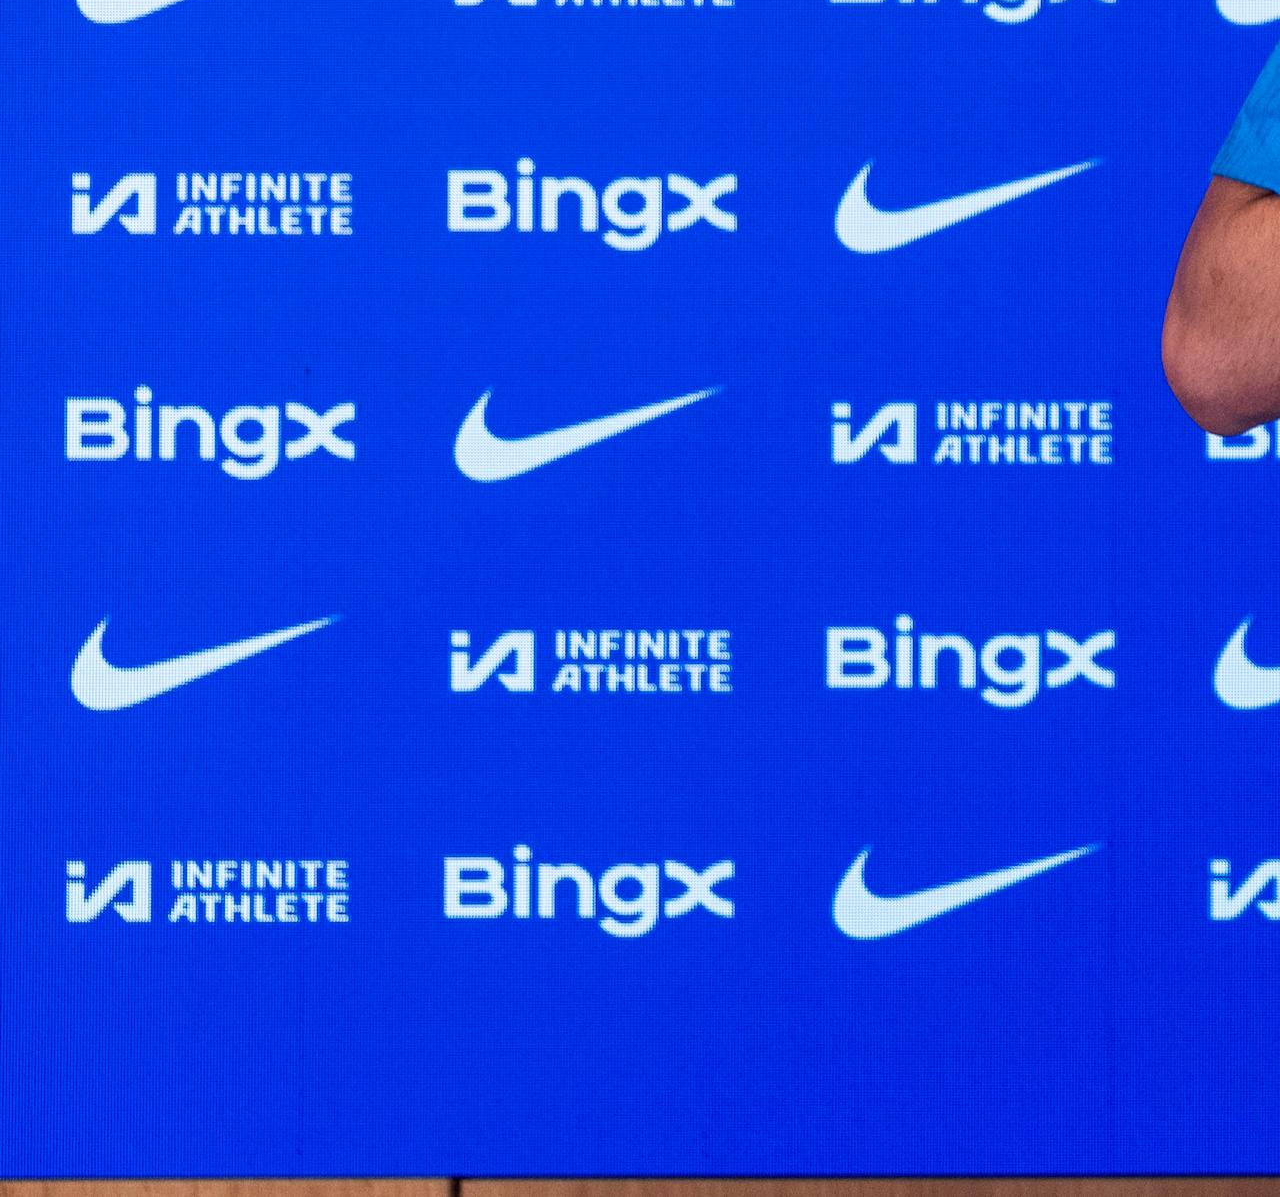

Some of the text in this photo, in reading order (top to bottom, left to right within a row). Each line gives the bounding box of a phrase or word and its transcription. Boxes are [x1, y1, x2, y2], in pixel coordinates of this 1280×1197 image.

[178, 174, 353, 203] INFINITE
[175, 208, 353, 236] ATHLETE
[939, 404, 1110, 431] INFINITE
[936, 436, 1110, 464] ATHLETE
[557, 631, 731, 660] INFINITE
[553, 665, 731, 692] ATHLETE
[175, 861, 347, 889] INFINITE
[171, 894, 349, 923] ATHLETE
